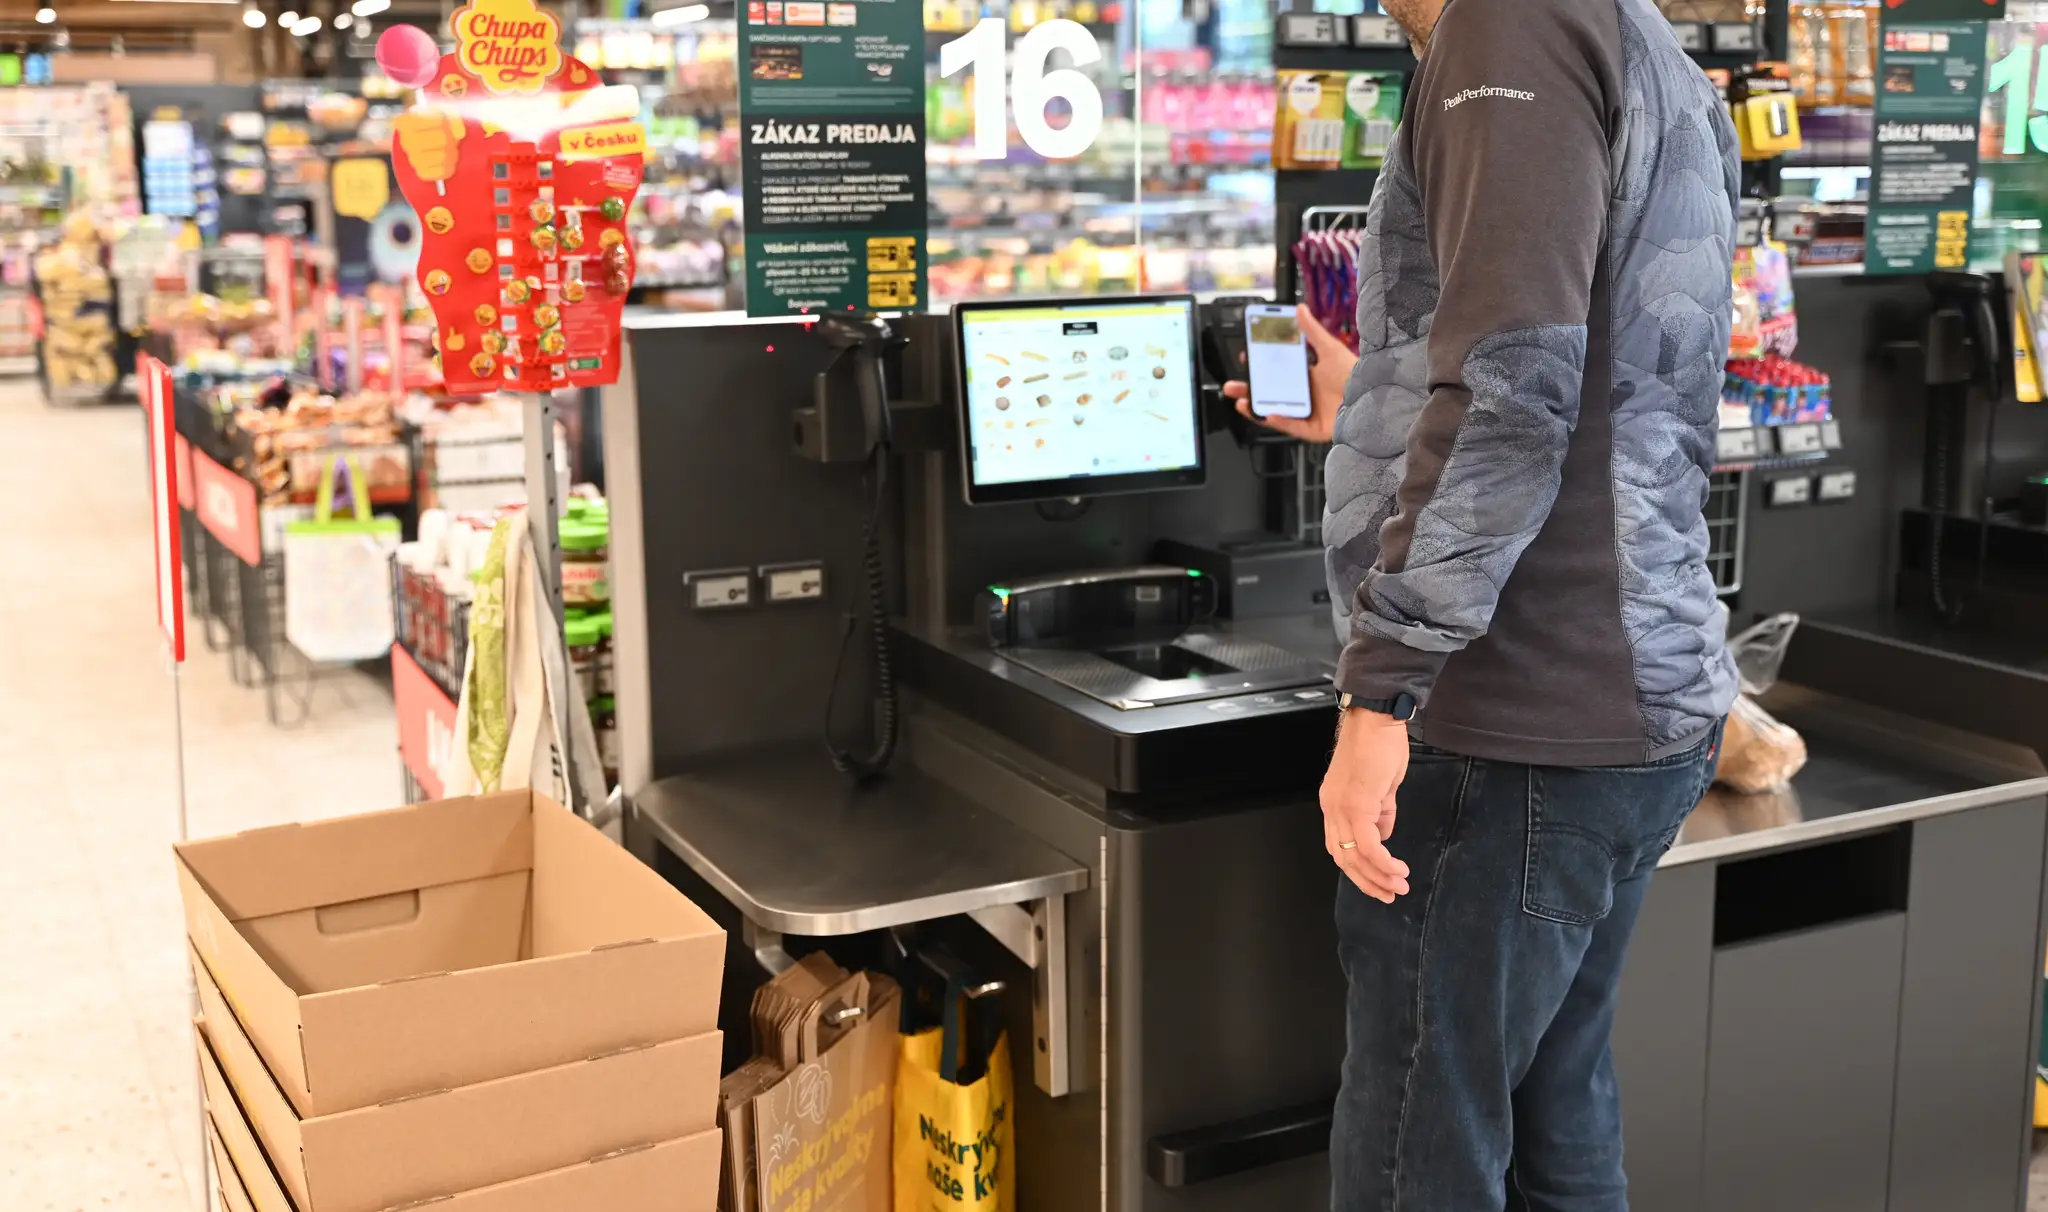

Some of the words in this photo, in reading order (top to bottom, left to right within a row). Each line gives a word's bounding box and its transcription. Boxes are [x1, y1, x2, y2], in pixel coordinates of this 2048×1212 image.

[469, 14, 547, 43] Chupa
[468, 40, 548, 69] Chups
[940, 18, 1103, 159] 16
[569, 140, 579, 149] v
[584, 131, 637, 148] Česku
[751, 119, 820, 144] ZÁKAZ
[826, 124, 916, 143] PREDAJA
